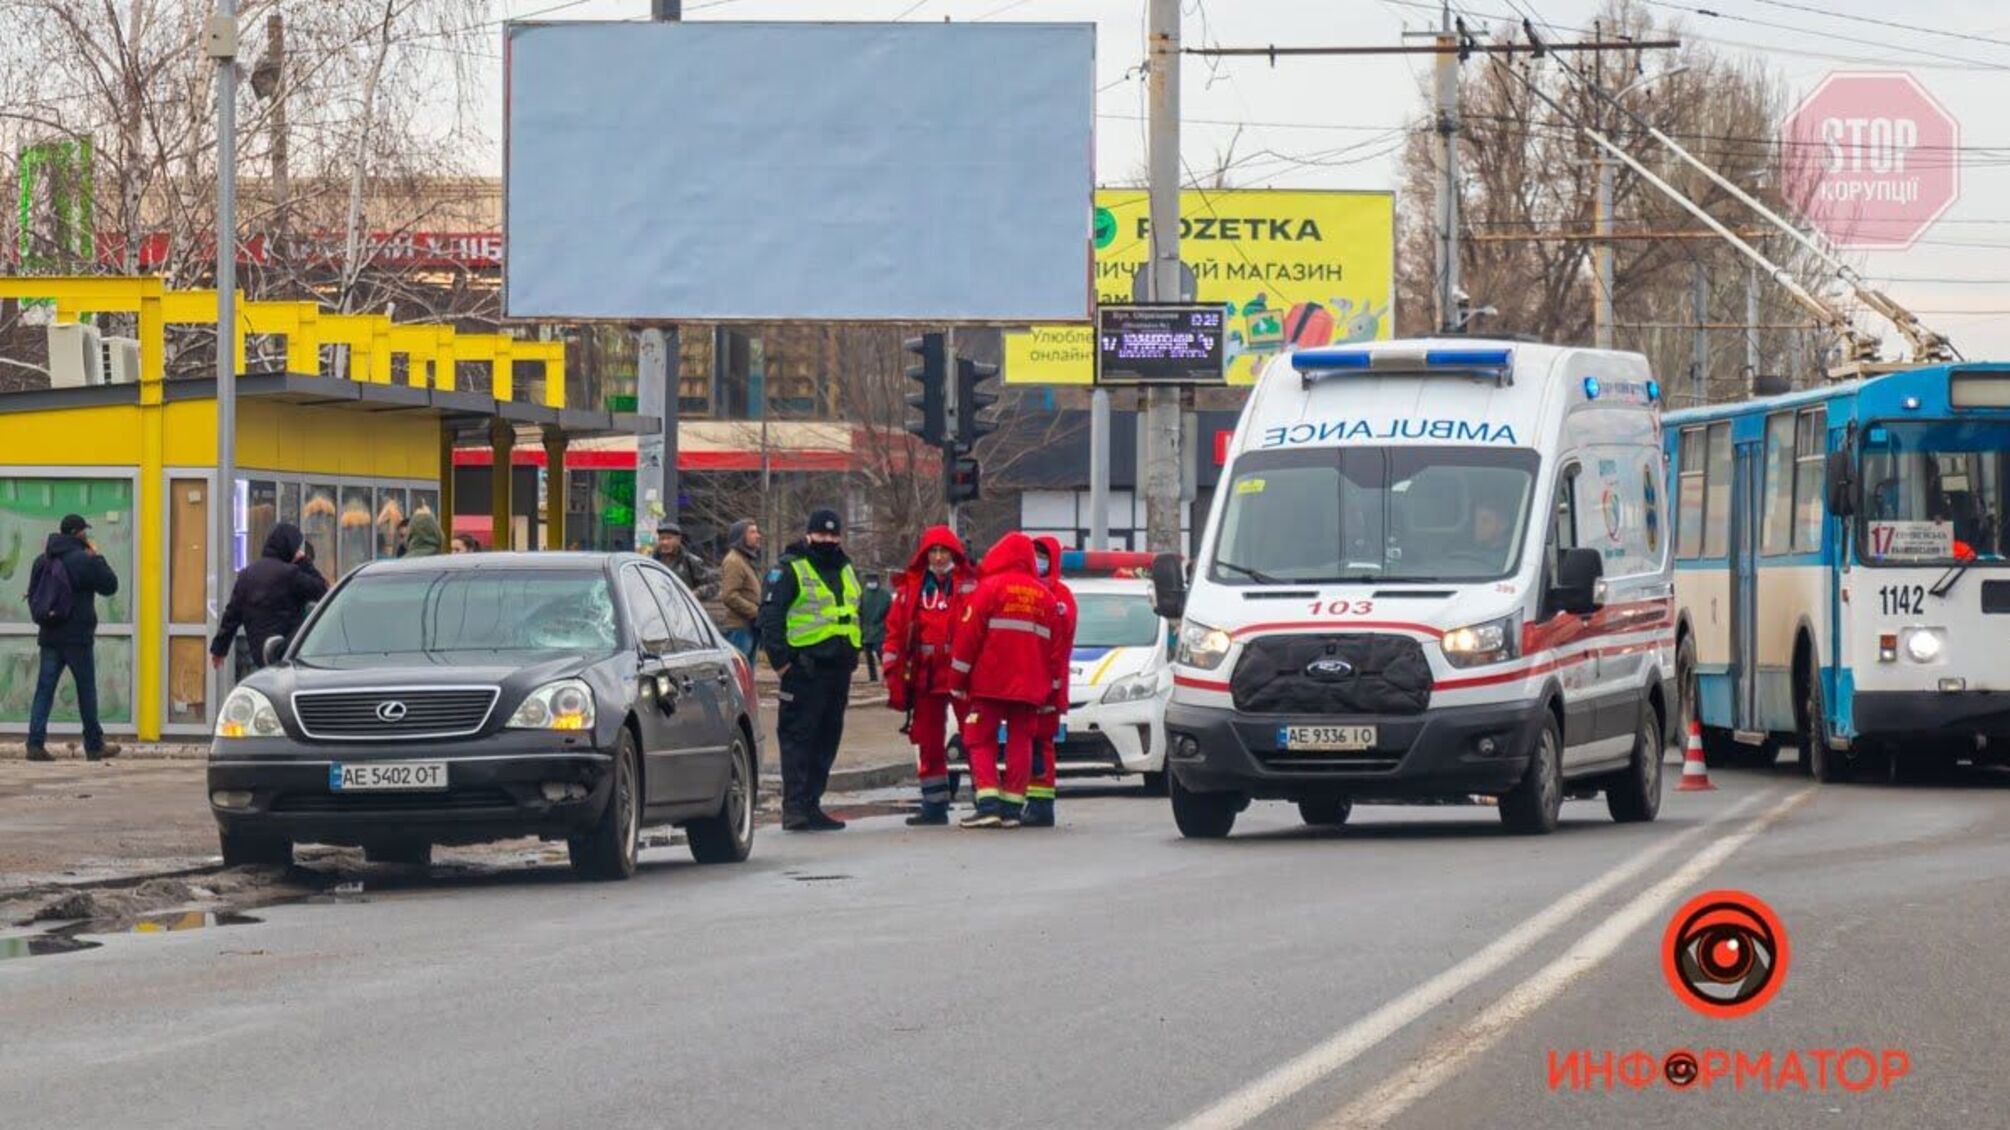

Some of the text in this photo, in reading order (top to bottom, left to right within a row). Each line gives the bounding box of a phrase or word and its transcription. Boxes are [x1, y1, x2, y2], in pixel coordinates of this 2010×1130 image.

[1226, 262, 1343, 281] МАГАЗИН
[1871, 526, 1895, 558] 17
[1307, 600, 1374, 615] 103
[1879, 585, 1924, 615] 1142
[1289, 728, 1309, 743] AE
[1313, 728, 1346, 743] 9336
[343, 766, 441, 785] AE 5402 OT
